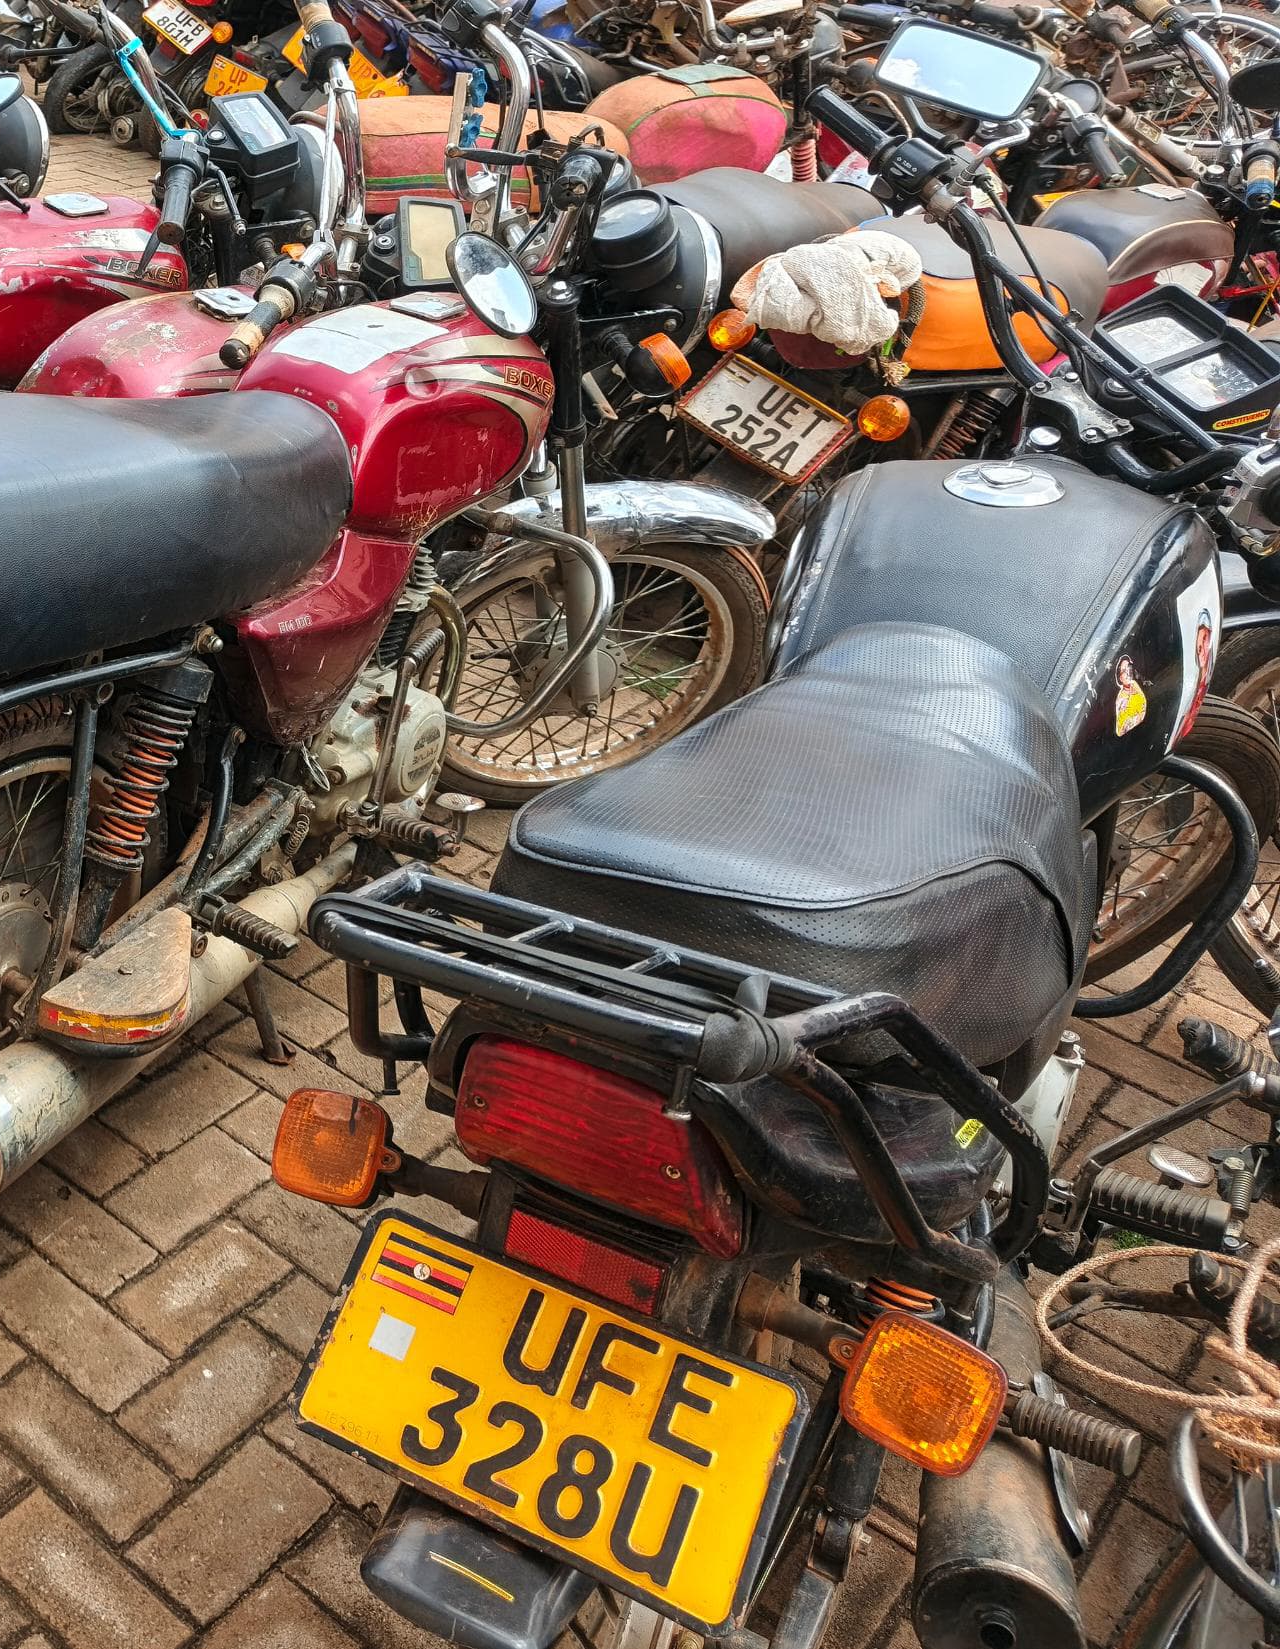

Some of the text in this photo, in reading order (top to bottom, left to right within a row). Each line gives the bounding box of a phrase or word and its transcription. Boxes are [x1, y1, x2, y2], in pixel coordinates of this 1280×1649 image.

[175, 10, 205, 36] UFB
[229, 66, 249, 86] UP
[503, 363, 554, 399] BOXE
[710, 404, 800, 471] 252A
[756, 384, 832, 439] UET
[502, 1288, 735, 1468] UFE
[399, 1365, 700, 1588] 328U
